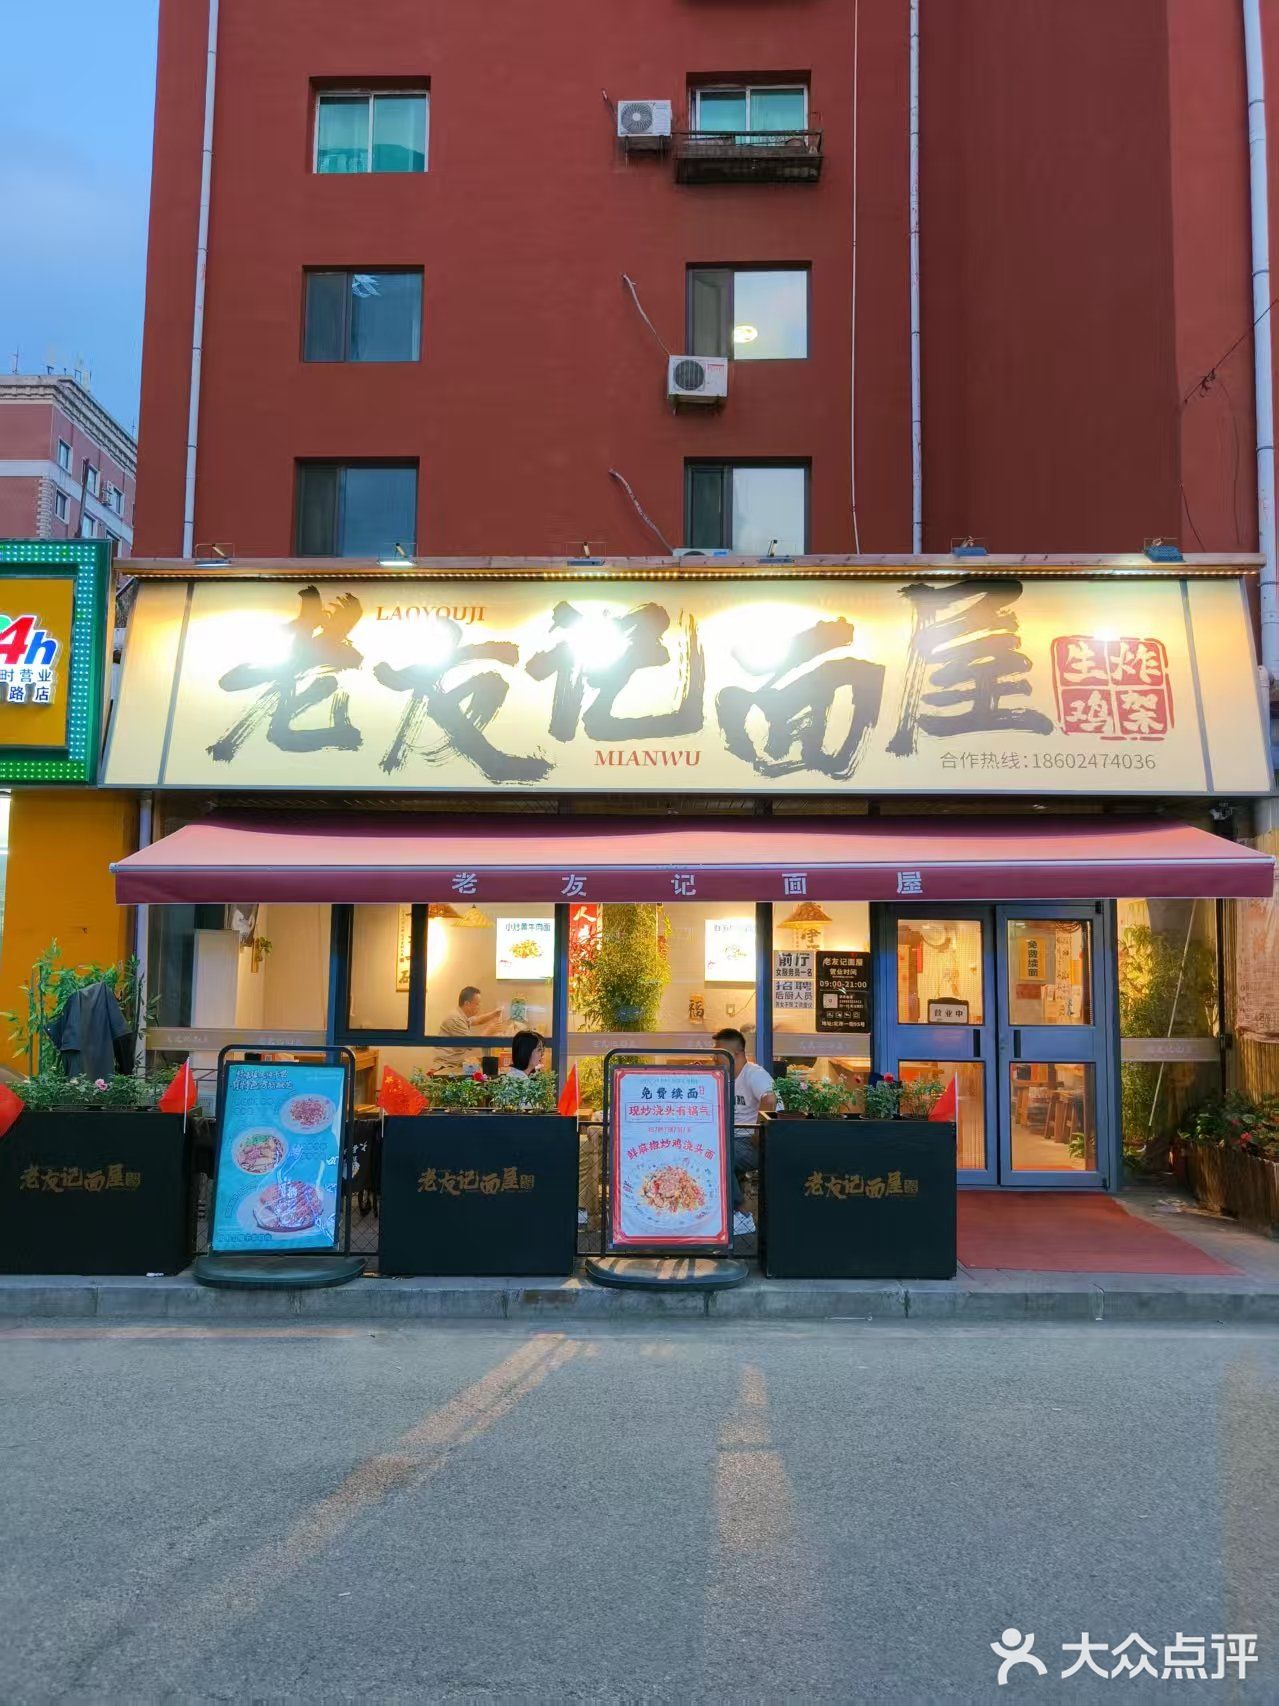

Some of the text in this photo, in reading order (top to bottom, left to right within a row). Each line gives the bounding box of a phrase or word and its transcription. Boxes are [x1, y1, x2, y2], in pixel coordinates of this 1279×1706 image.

[206, 579, 1055, 785] 老友记面屋
[593, 750, 702, 766] MIANWU
[451, 871, 924, 897] 老友记面屋
[819, 980, 868, 989] 09:00-21:00
[934, 1008, 964, 1018] 营业中
[641, 1086, 699, 1100] 免费续面
